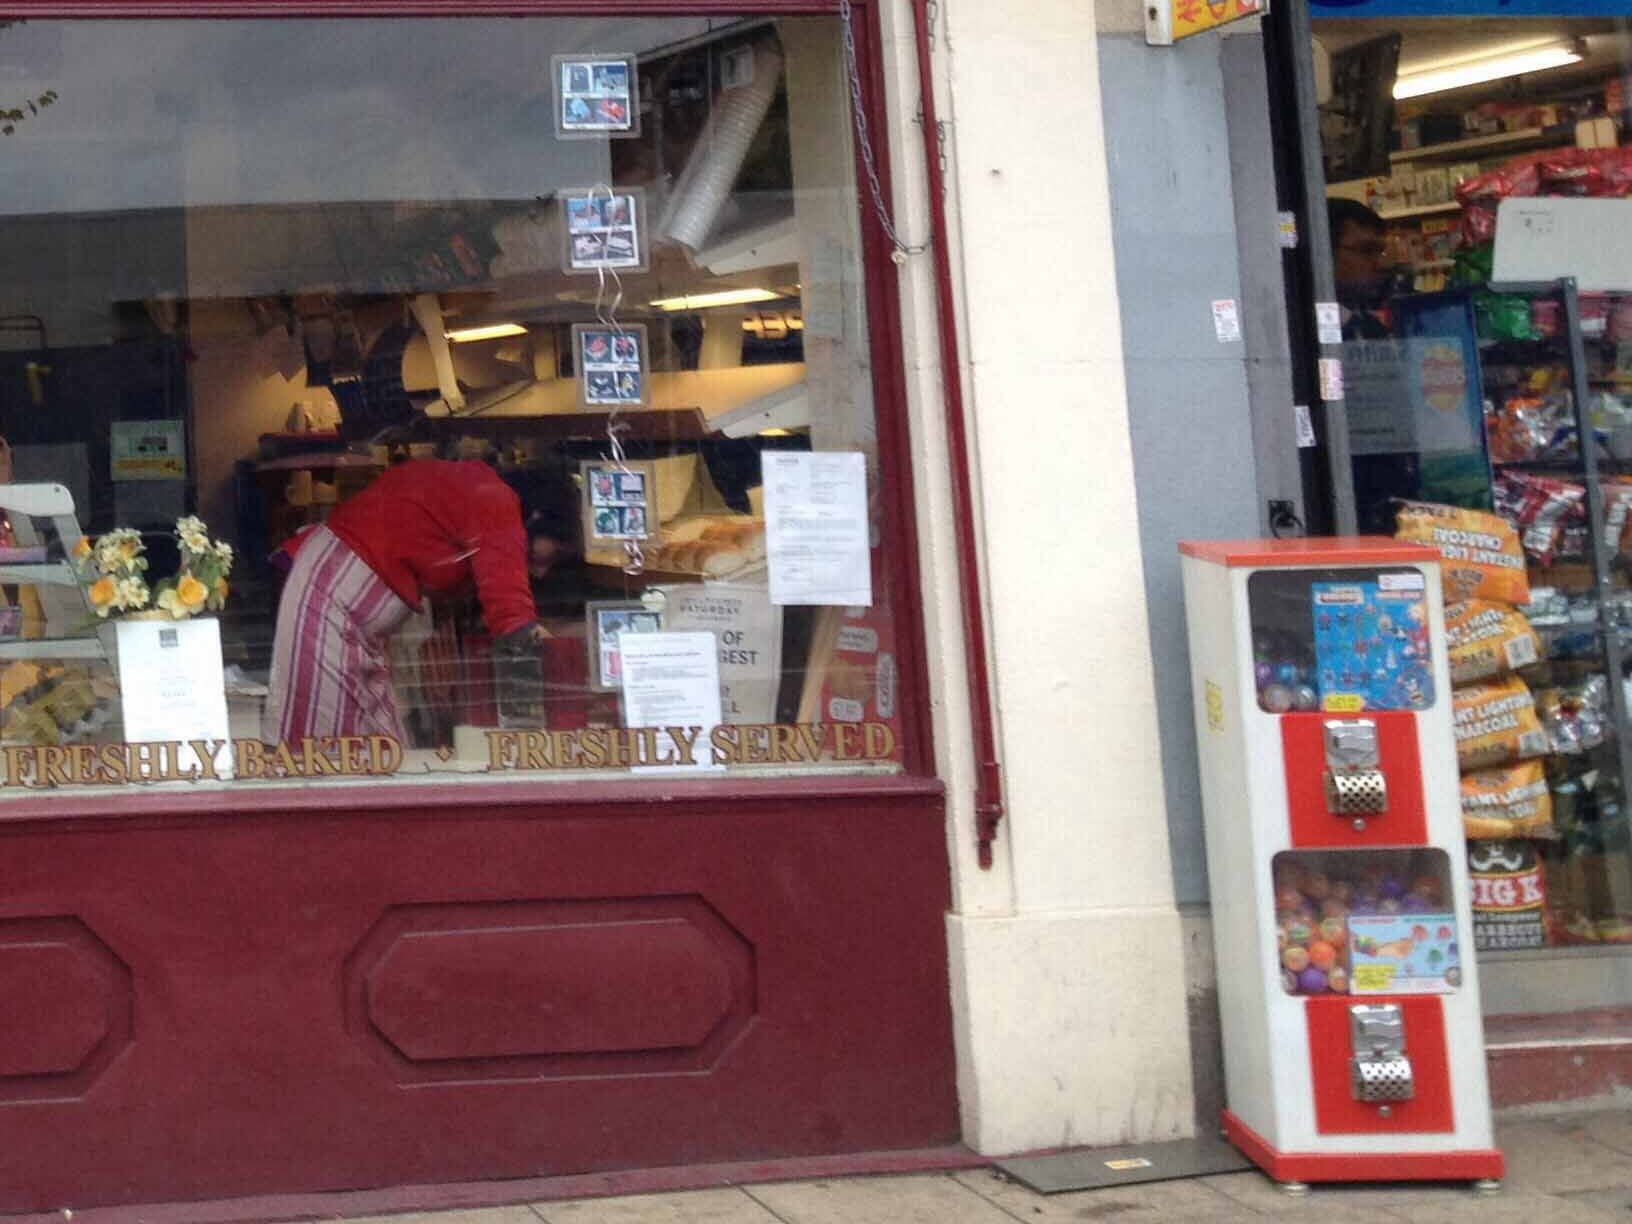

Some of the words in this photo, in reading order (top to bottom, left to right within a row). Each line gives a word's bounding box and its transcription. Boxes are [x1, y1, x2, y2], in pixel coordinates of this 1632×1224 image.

[722, 629, 745, 646] OF
[719, 649, 760, 666] GEST
[2, 739, 226, 789] FRESHLY
[231, 735, 403, 780] BAKED
[484, 726, 703, 772] FRESHLY
[711, 722, 896, 767] SERVED
